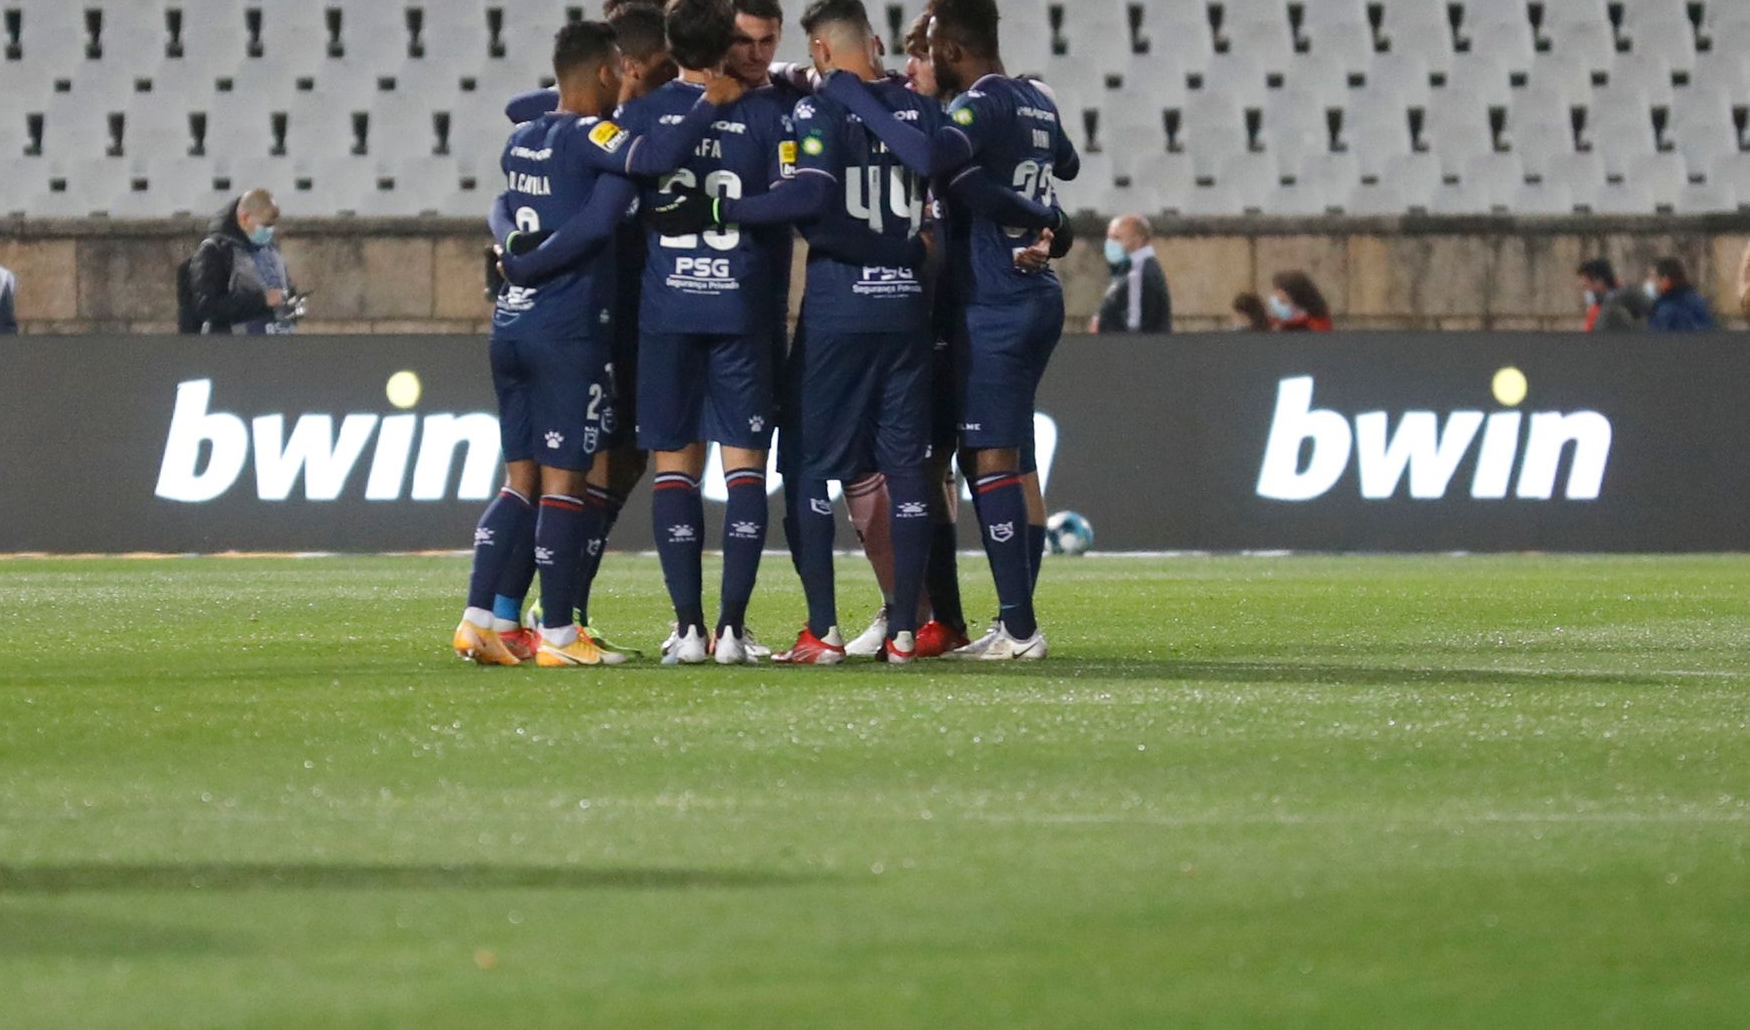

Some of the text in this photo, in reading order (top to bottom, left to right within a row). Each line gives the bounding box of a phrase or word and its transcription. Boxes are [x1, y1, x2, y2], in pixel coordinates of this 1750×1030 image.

[845, 165, 923, 241] 44
[675, 257, 729, 278] PSG
[155, 369, 502, 503] bwin
[586, 383, 602, 420] 2
[1256, 366, 1612, 501] bwin
